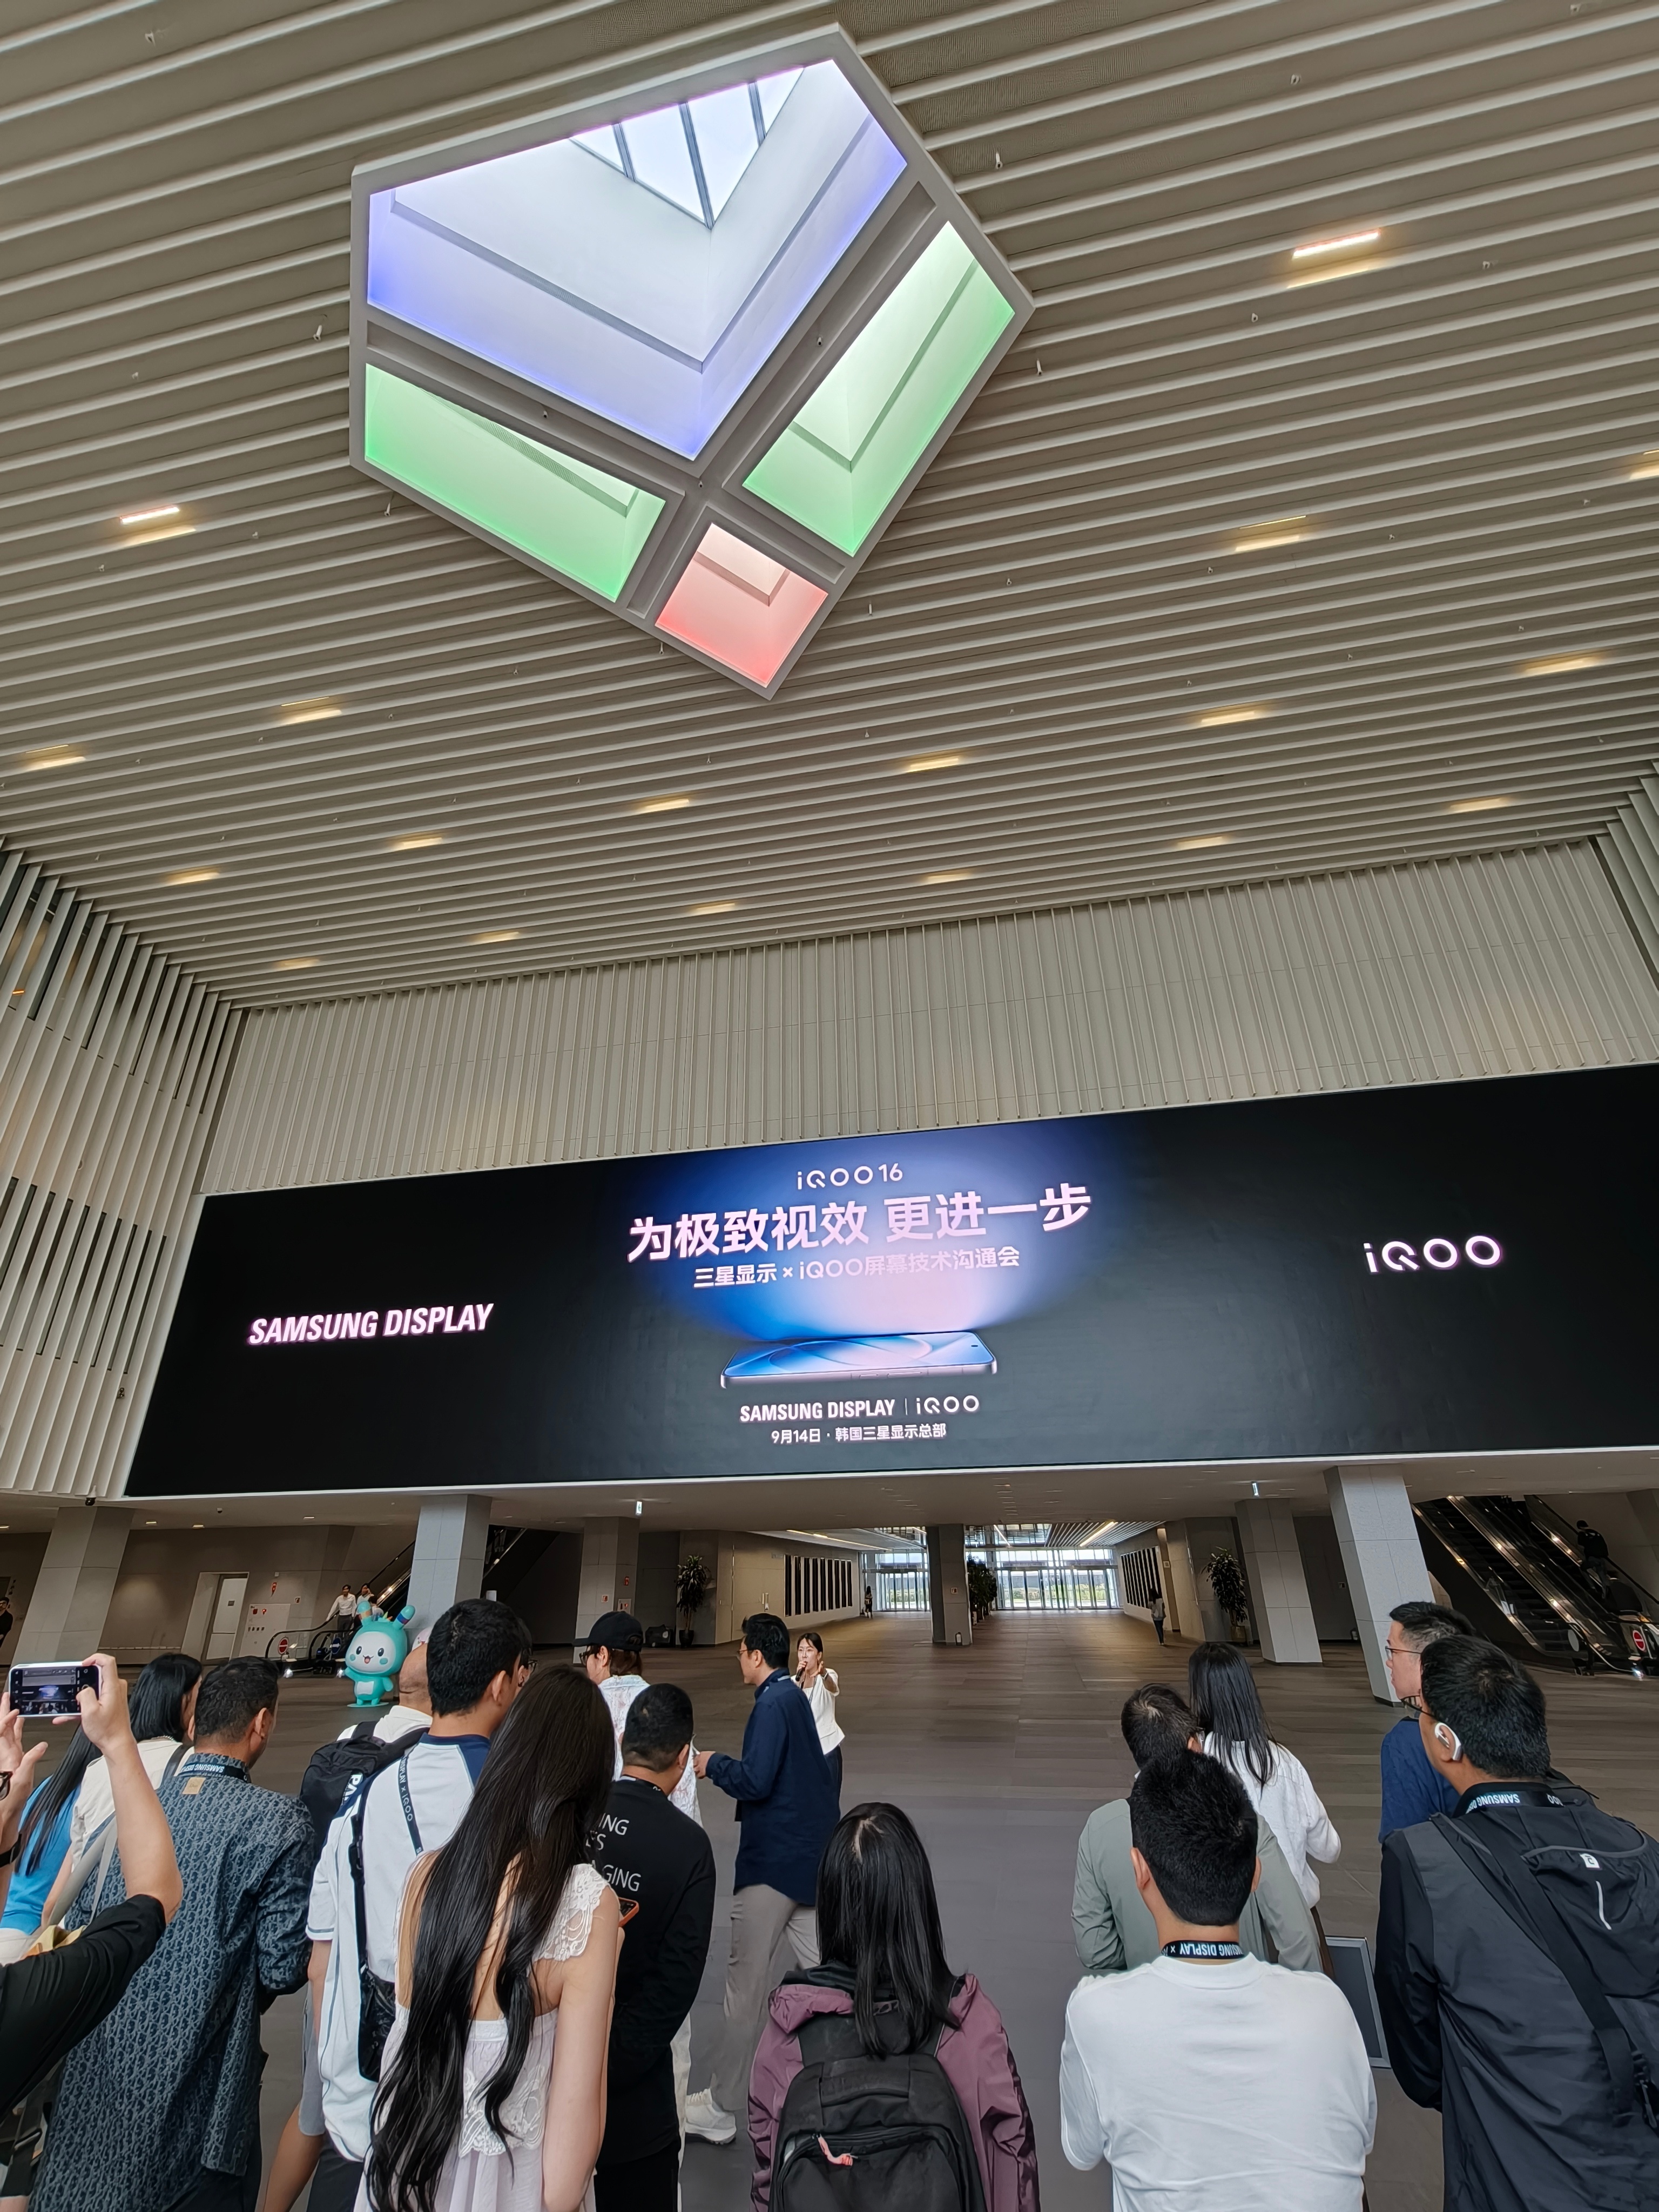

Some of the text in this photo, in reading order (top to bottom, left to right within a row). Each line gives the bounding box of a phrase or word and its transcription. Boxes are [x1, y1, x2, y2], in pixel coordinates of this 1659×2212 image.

[627, 1183, 1091, 1263] 为极致视效 更进一步
[1363, 1235, 1501, 1273] iQOO
[693, 1263, 777, 1288] 三星显示
[249, 1303, 494, 1344] SAMSUNG DISPLAY
[740, 1395, 979, 1422] SAMSUNG DISPLAY iQOO
[771, 1428, 821, 1445] 9月14日
[835, 1423, 947, 1442] 韩国三星显示总部
[194, 1764, 225, 1773] SAMSUNG
[1476, 1793, 1520, 1806] SAMSUNG
[1179, 1942, 1217, 1956] DISPLAY
